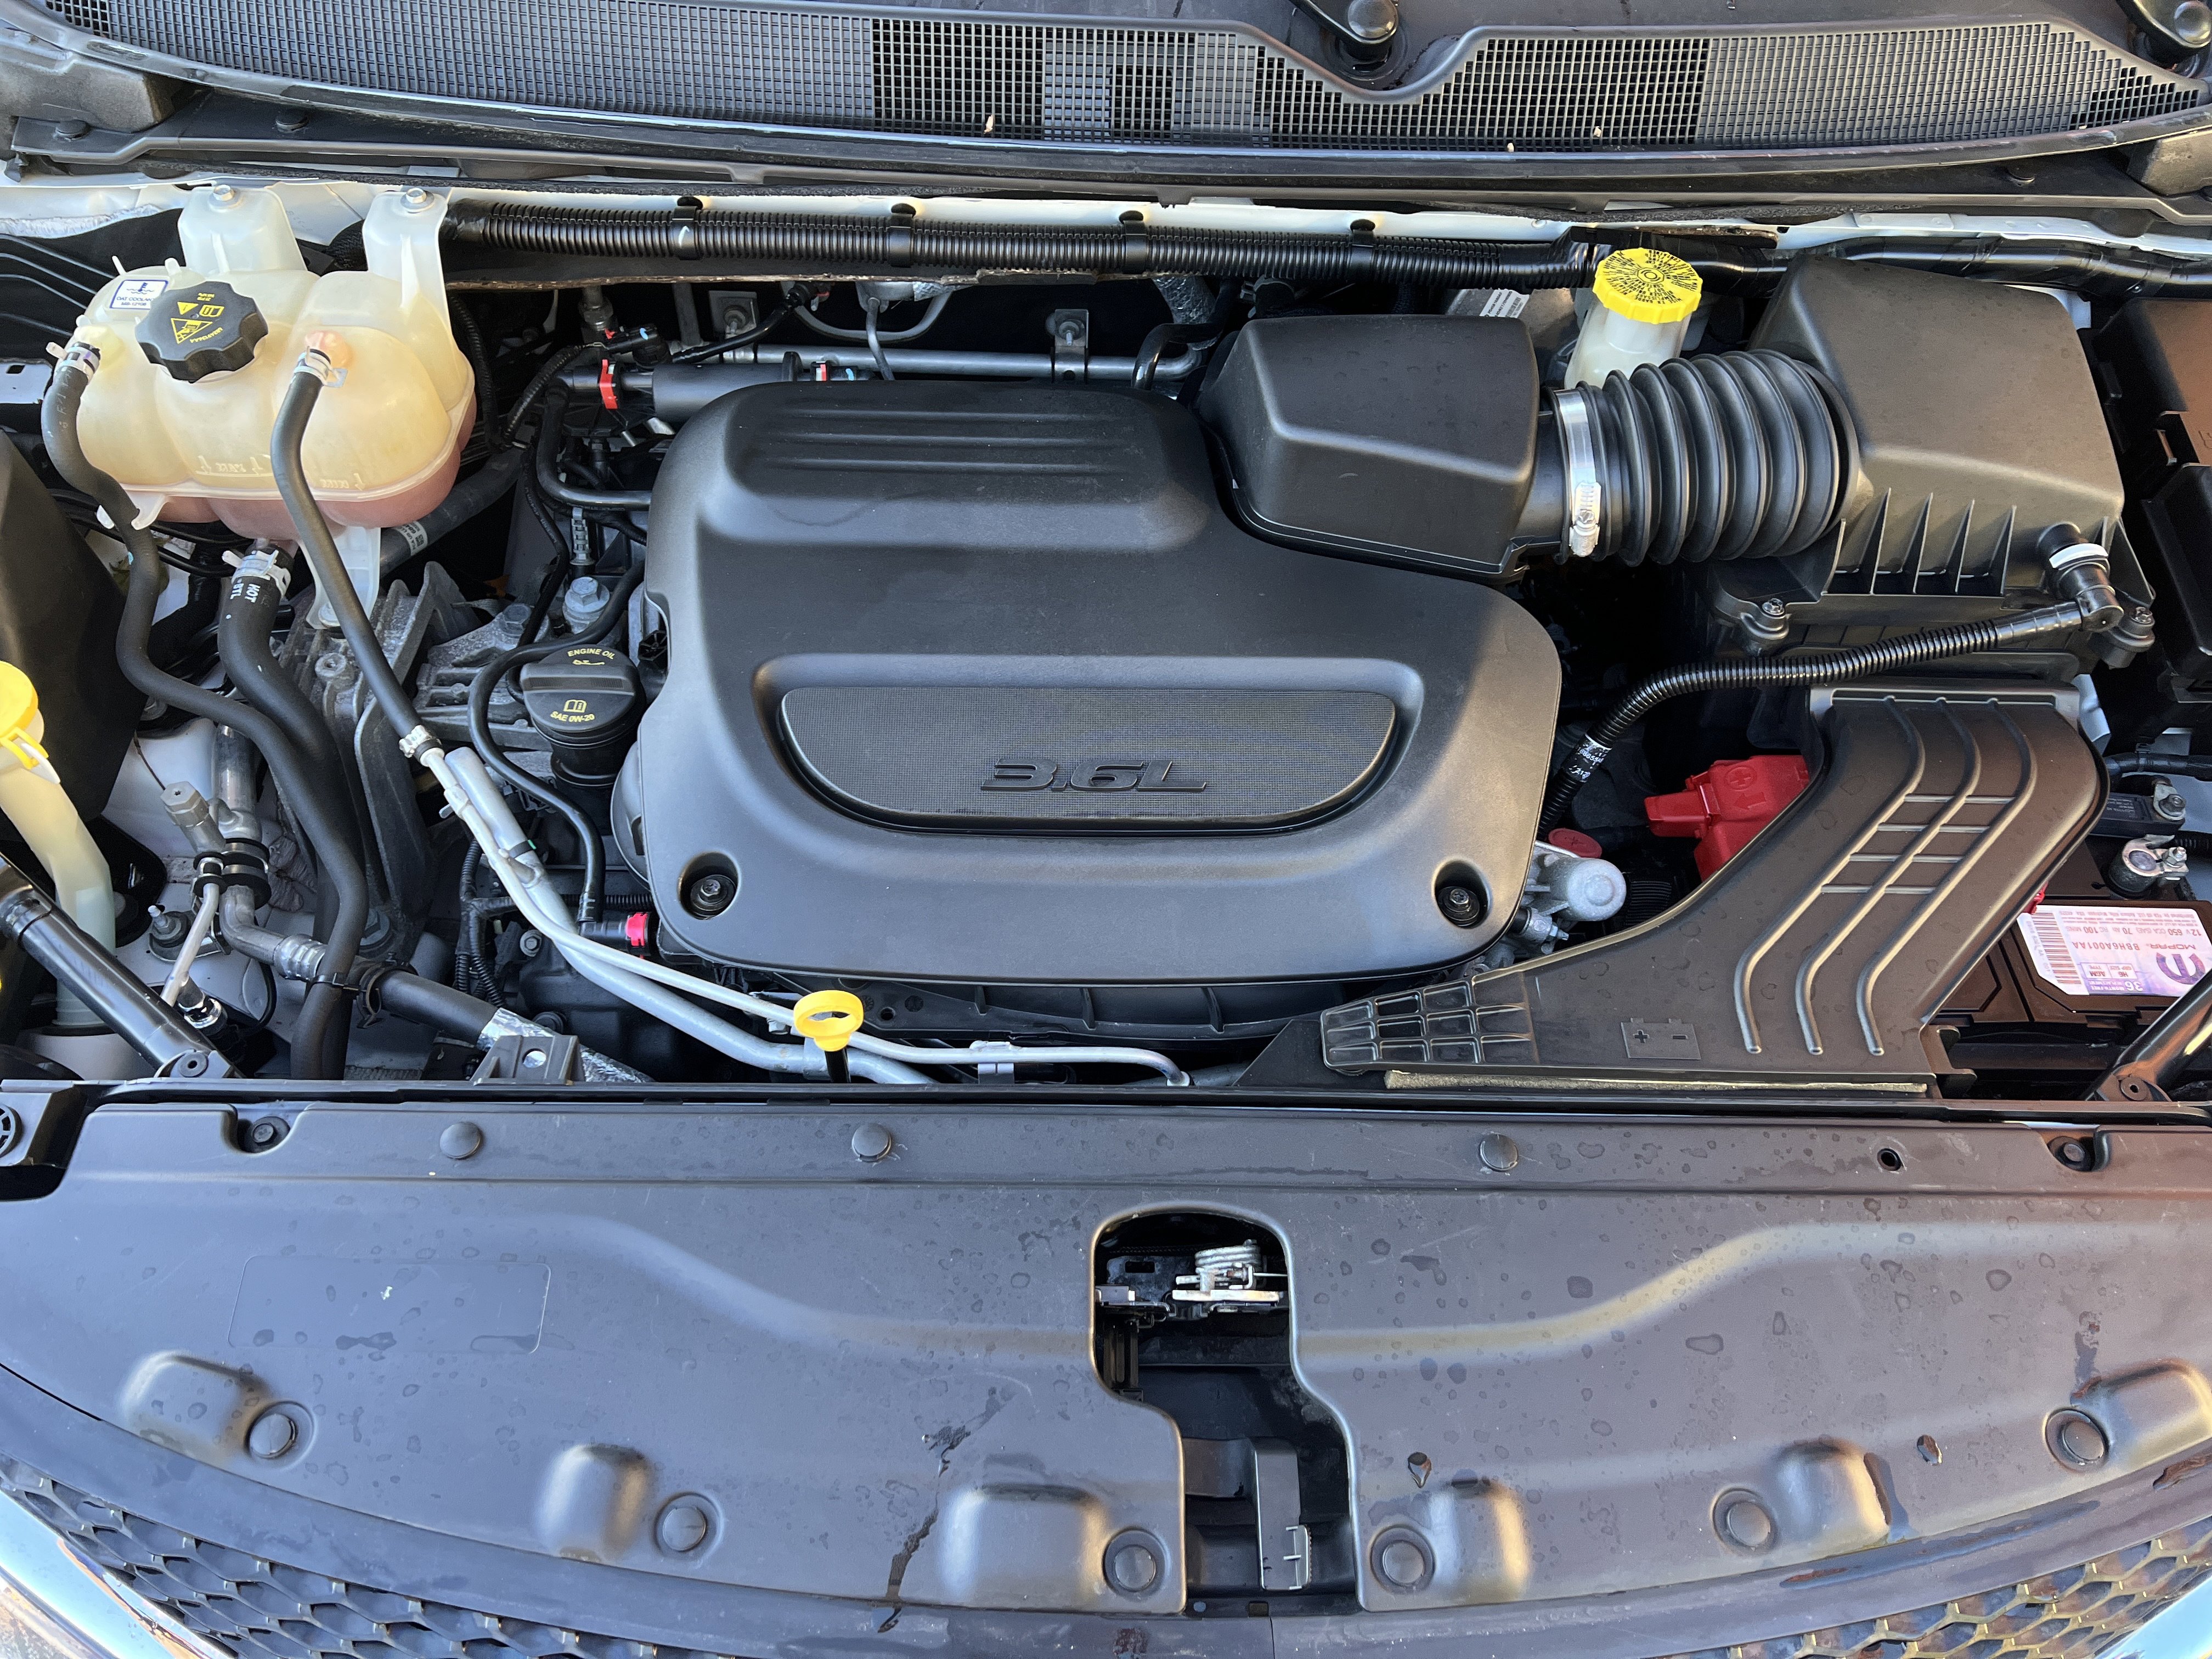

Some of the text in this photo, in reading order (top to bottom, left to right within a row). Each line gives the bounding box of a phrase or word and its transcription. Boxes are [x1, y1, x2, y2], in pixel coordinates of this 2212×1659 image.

[245, 583, 261, 603] HOT
[567, 648, 616, 660] ENGINE OIL
[550, 711, 595, 723] SAE 0W-20
[981, 758, 1206, 792] 3.6L
[2072, 941, 2140, 951] BBH6A001AA
[2124, 980, 2143, 991] 36
